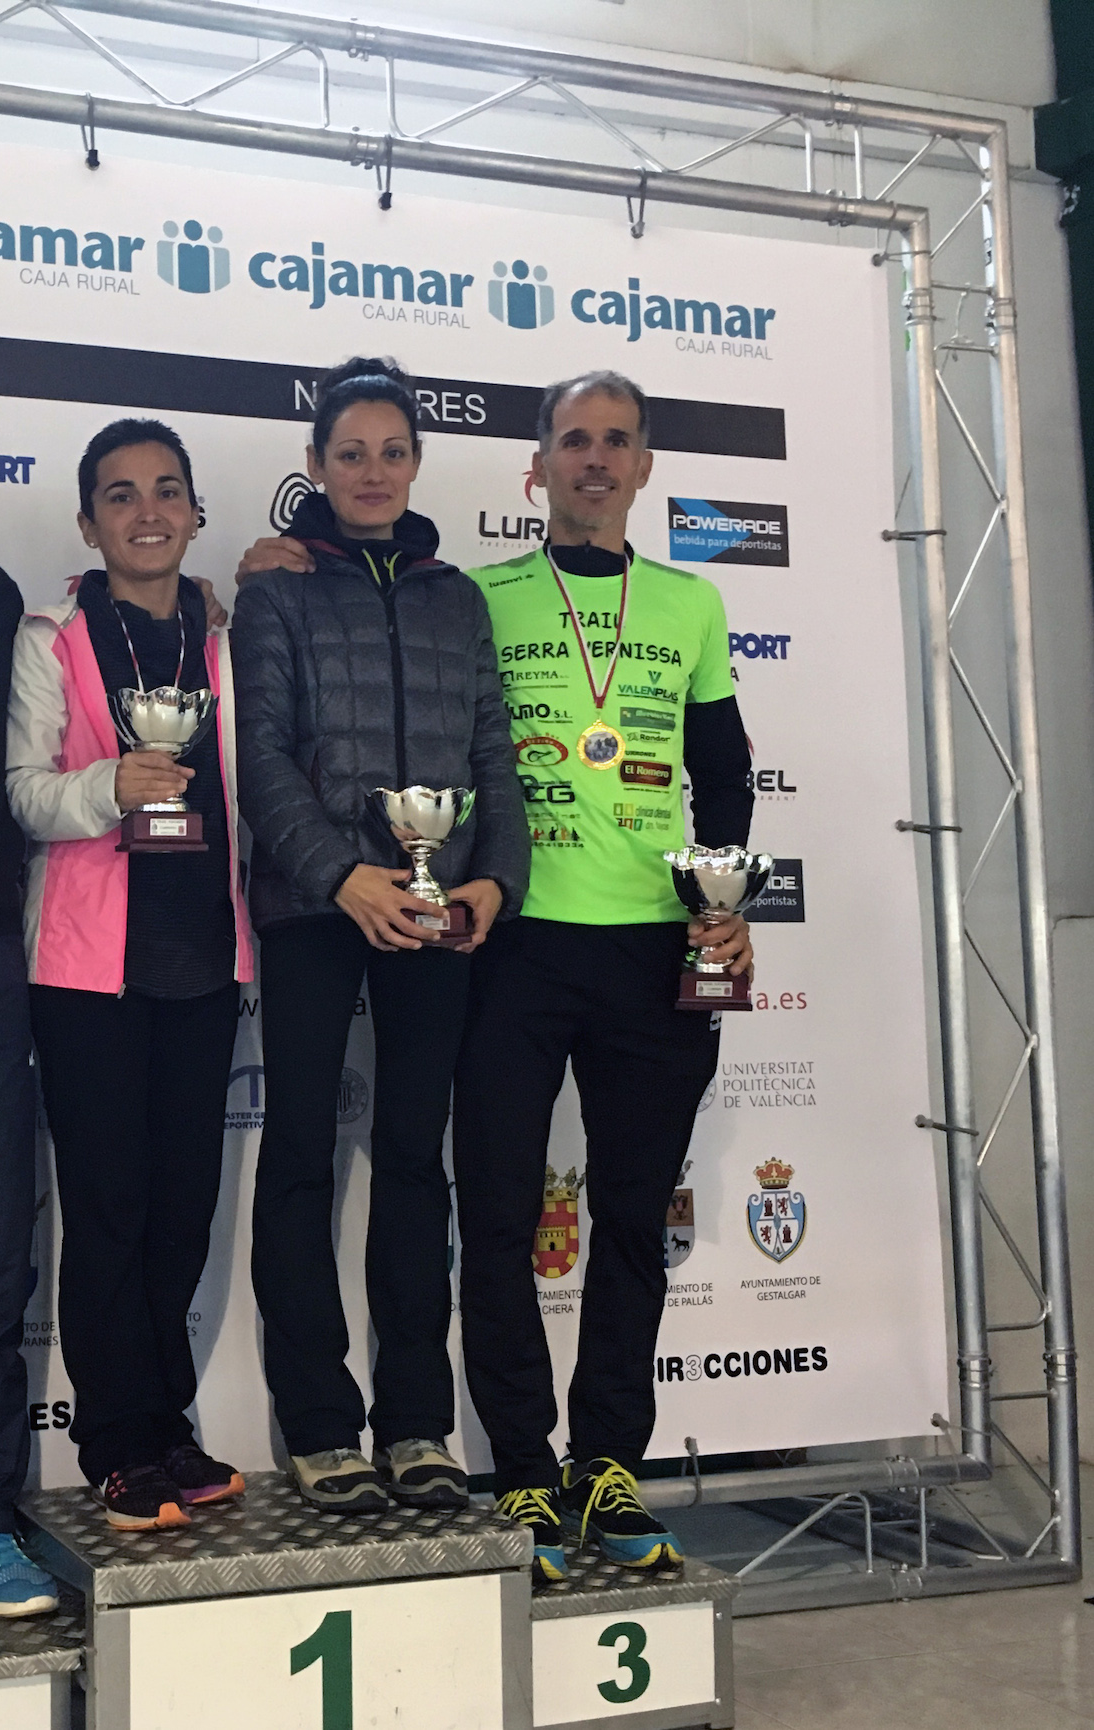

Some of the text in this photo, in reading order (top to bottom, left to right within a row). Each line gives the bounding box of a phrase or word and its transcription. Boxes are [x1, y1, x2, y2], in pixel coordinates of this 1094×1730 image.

[19, 268, 140, 296] CAJA RURAL
[248, 242, 474, 309] cajamar
[362, 303, 470, 329] CAJA RURAL
[570, 277, 776, 341] cajamar
[675, 336, 773, 361] CAJA RURAL
[673, 514, 781, 535] POWERADE
[674, 534, 782, 551] bebida para deportistas
[501, 642, 569, 663] SERRA
[516, 670, 559, 681] REYMA
[624, 764, 670, 778] El Romero
[722, 1061, 814, 1076] UNIVERSITAT
[723, 1075, 816, 1092] POLITÈCNICA
[724, 1091, 817, 1108] DE VALÈNCIA
[702, 1282, 713, 1292] DE
[740, 1275, 821, 1289] AYUNTAMIENTO DE
[667, 1295, 713, 1307] DE PALLÁS
[757, 1290, 807, 1301] GESTALGAR
[542, 1304, 574, 1315] CHERA
[41, 1321, 55, 1331] DE
[290, 1609, 353, 1730] 1
[597, 1620, 651, 1704] 3
